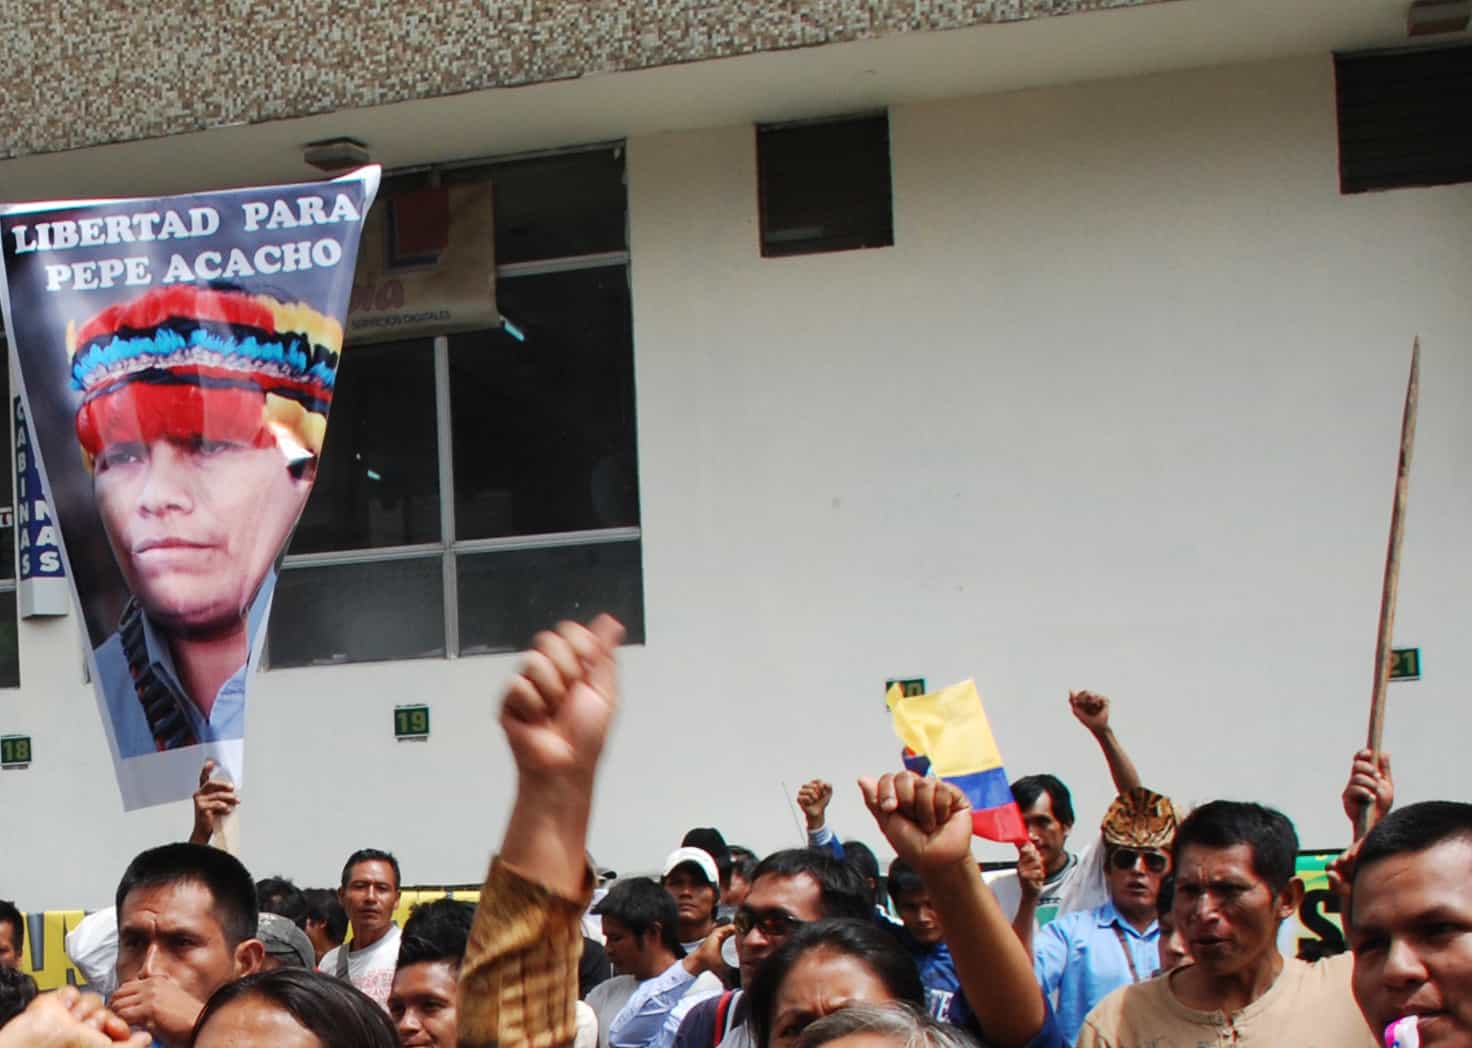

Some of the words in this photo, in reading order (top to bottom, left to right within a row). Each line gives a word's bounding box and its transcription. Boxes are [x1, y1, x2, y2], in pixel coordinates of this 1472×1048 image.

[12, 208, 220, 254] LIBERTAD
[242, 194, 362, 232] PARA
[45, 255, 152, 291] PEPE
[162, 239, 342, 283] ACACHO
[396, 711, 426, 736] 19
[3, 738, 28, 762] 18
